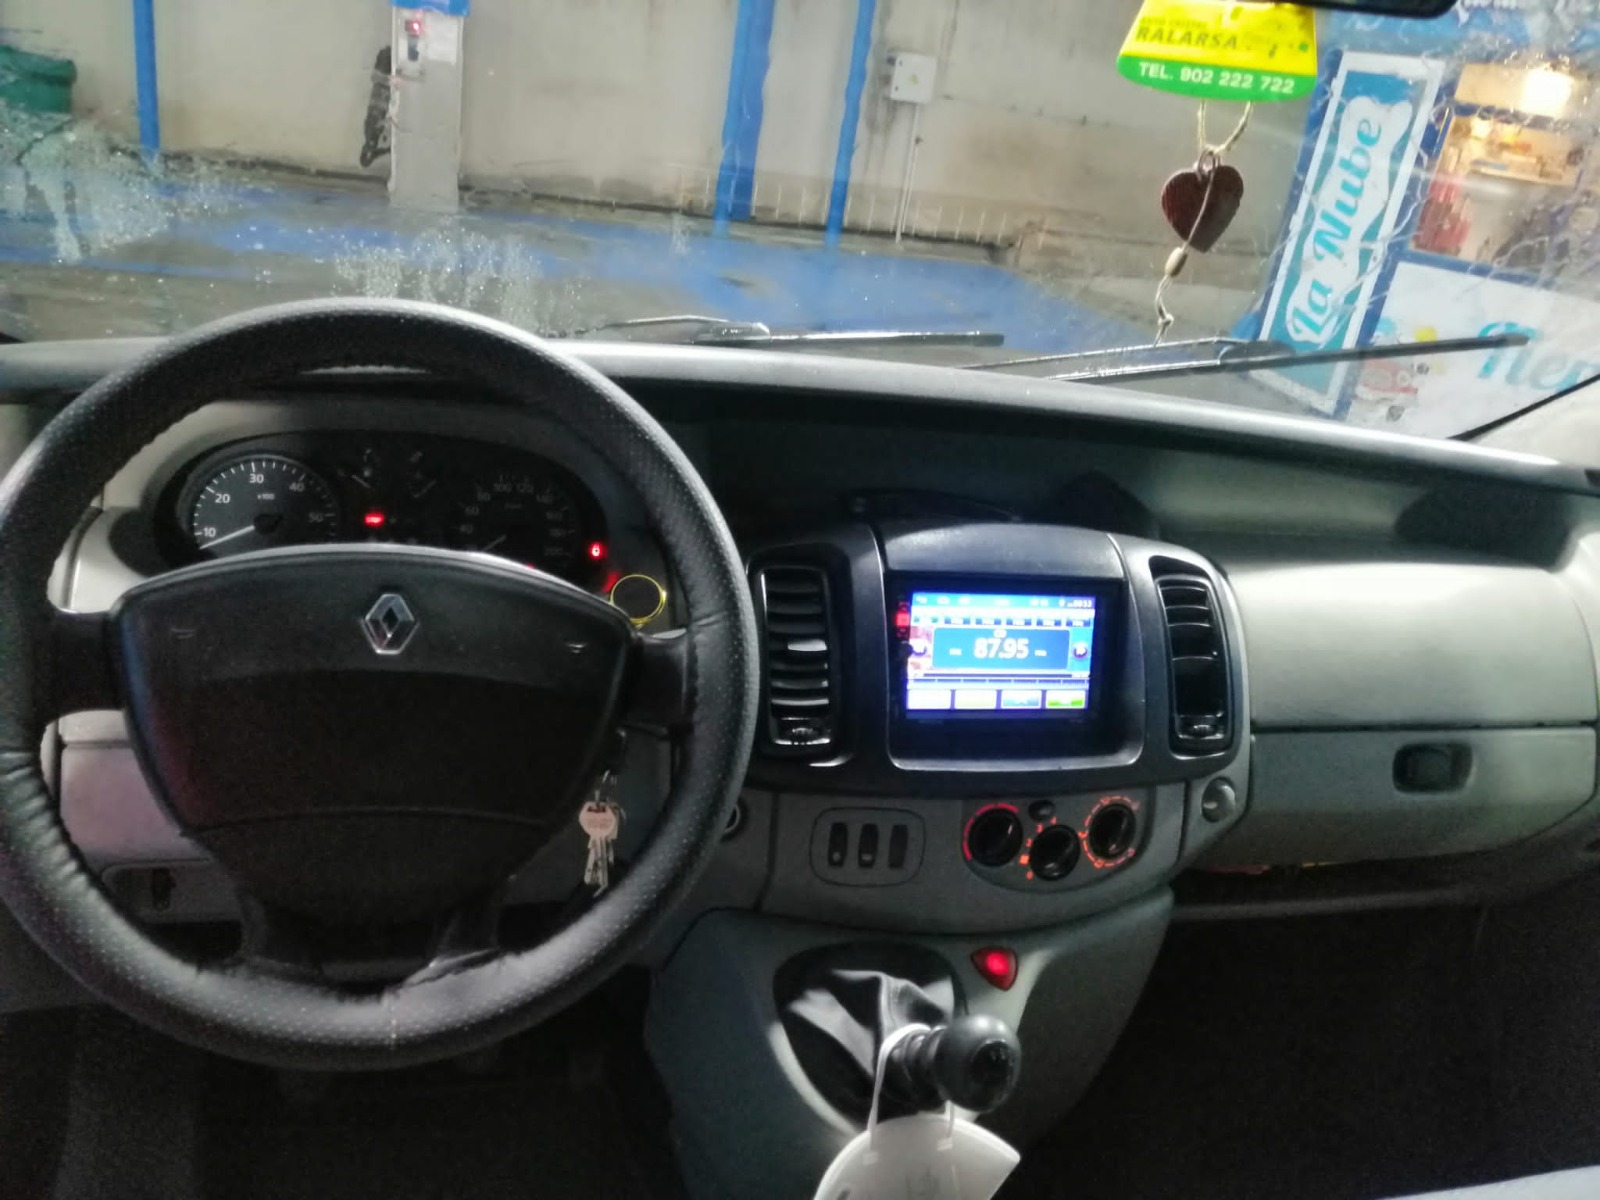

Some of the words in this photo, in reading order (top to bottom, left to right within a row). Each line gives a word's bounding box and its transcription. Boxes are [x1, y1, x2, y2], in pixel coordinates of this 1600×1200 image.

[1136, 26, 1238, 50] RALARSA
[1139, 61, 1174, 80] TEL.
[1180, 66, 1214, 84] 902
[1218, 70, 1254, 89] 222
[1260, 75, 1295, 94] 722
[1291, 279, 1333, 335] La
[1313, 118, 1382, 261] Nube
[250, 473, 264, 484] 30
[289, 482, 304, 493] 40
[215, 492, 231, 503] 20
[203, 527, 217, 538] 10
[973, 638, 1029, 659] 87.95
